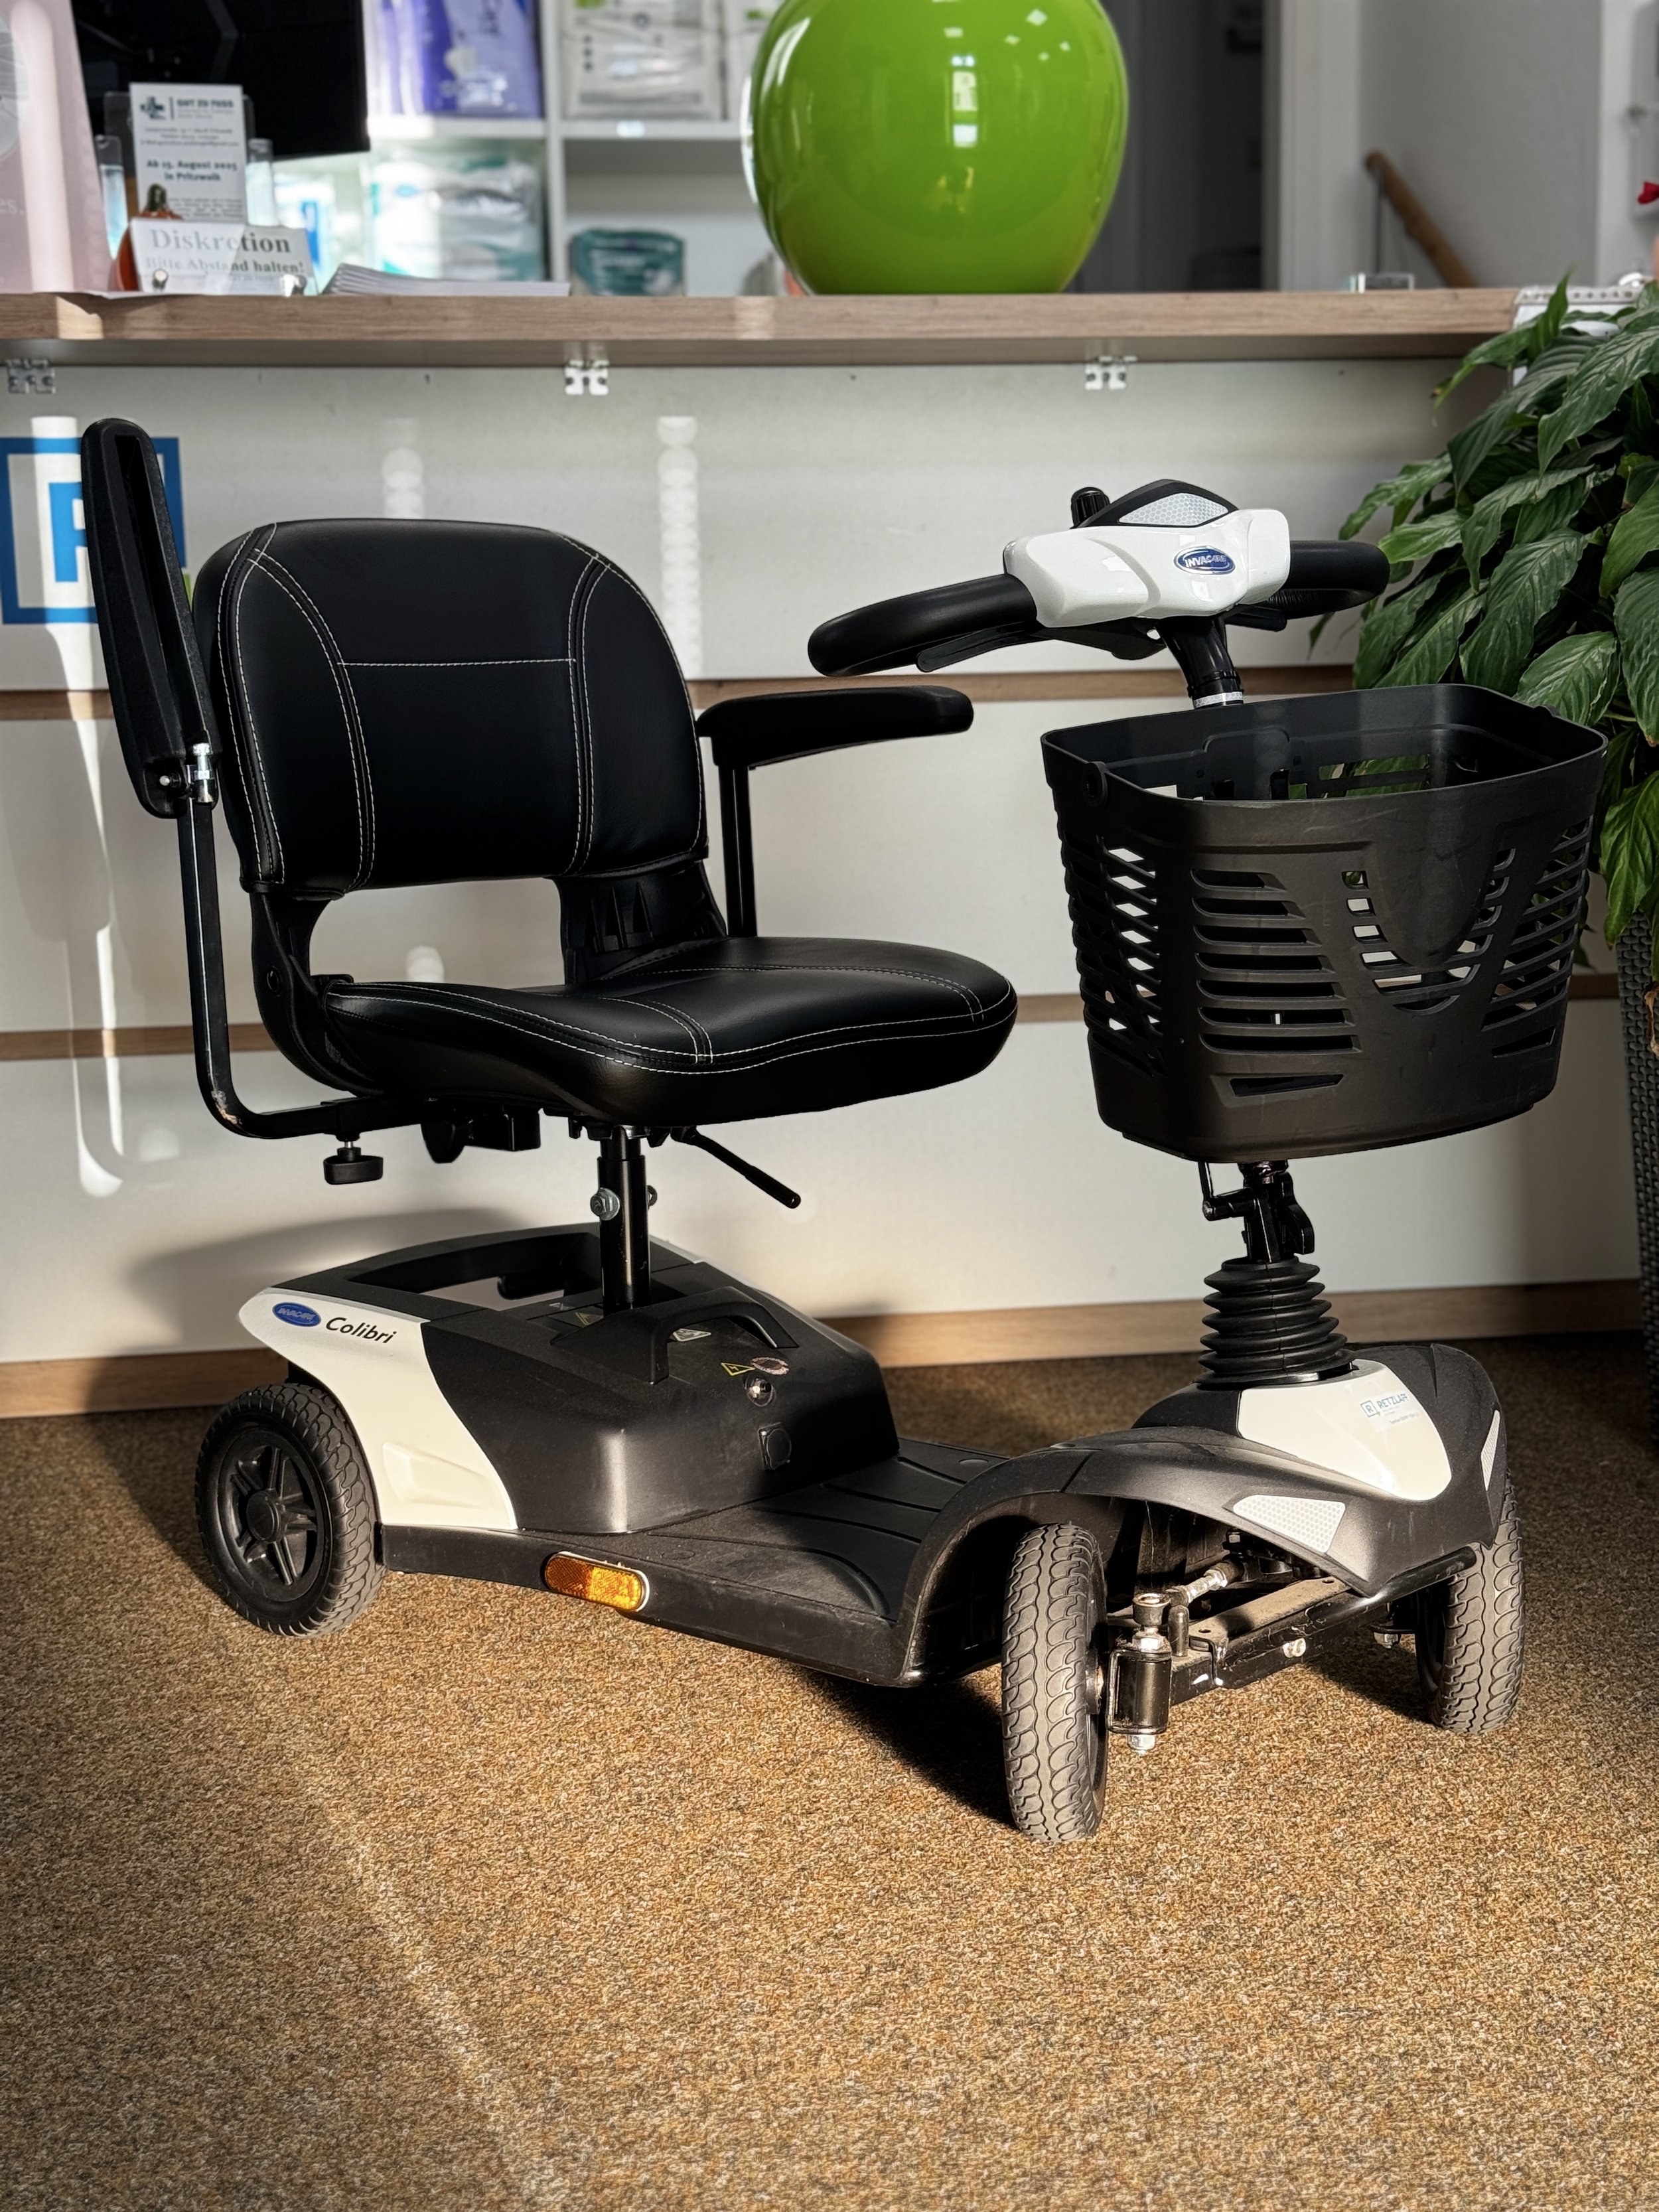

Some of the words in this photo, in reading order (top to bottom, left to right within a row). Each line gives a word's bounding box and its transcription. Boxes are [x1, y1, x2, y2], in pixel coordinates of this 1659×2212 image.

[178, 161, 212, 170] August
[214, 162, 237, 171] 2025
[151, 229, 291, 253] Diskretion
[146, 257, 182, 270] Bitte
[185, 259, 248, 271] Abstand
[254, 259, 305, 273] halten!
[1185, 555, 1227, 568] INVACARE
[326, 1317, 397, 1343] Colibri
